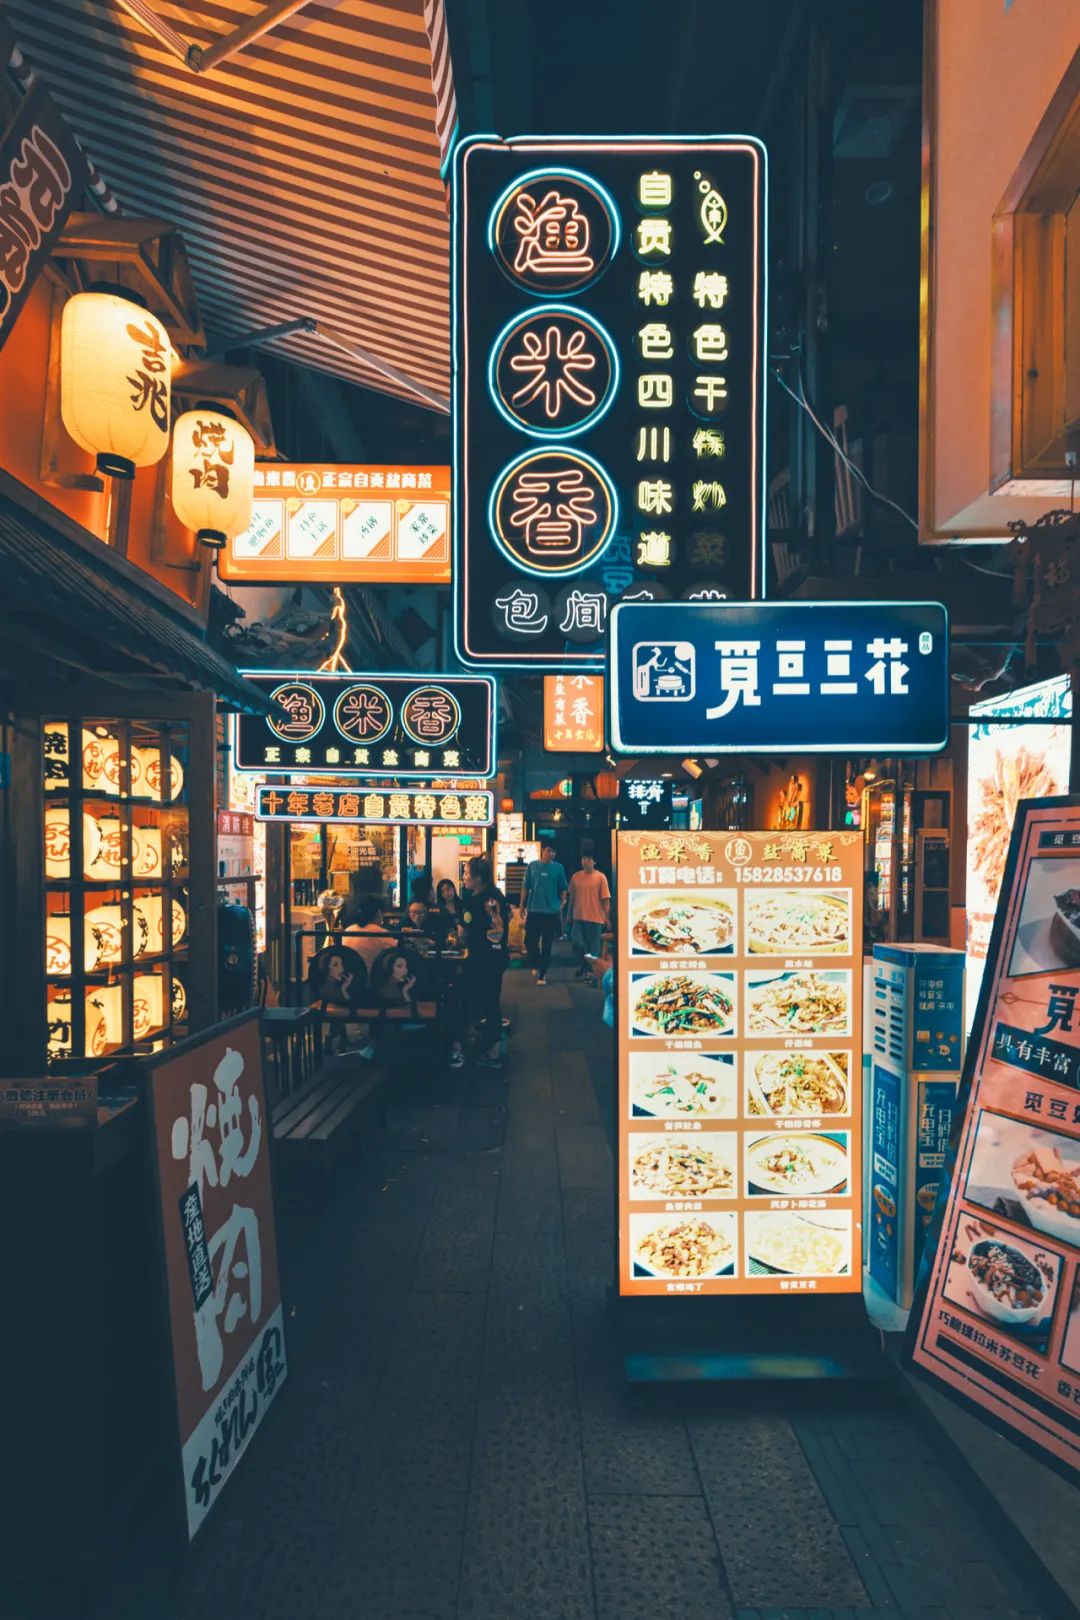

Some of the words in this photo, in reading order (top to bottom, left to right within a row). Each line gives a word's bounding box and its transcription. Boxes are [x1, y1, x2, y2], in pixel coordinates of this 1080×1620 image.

[636, 171, 674, 567] 自贡特色四川味道
[262, 792, 487, 820] 十年老店自贡特色菜
[734, 866, 842, 883] 15828537618
